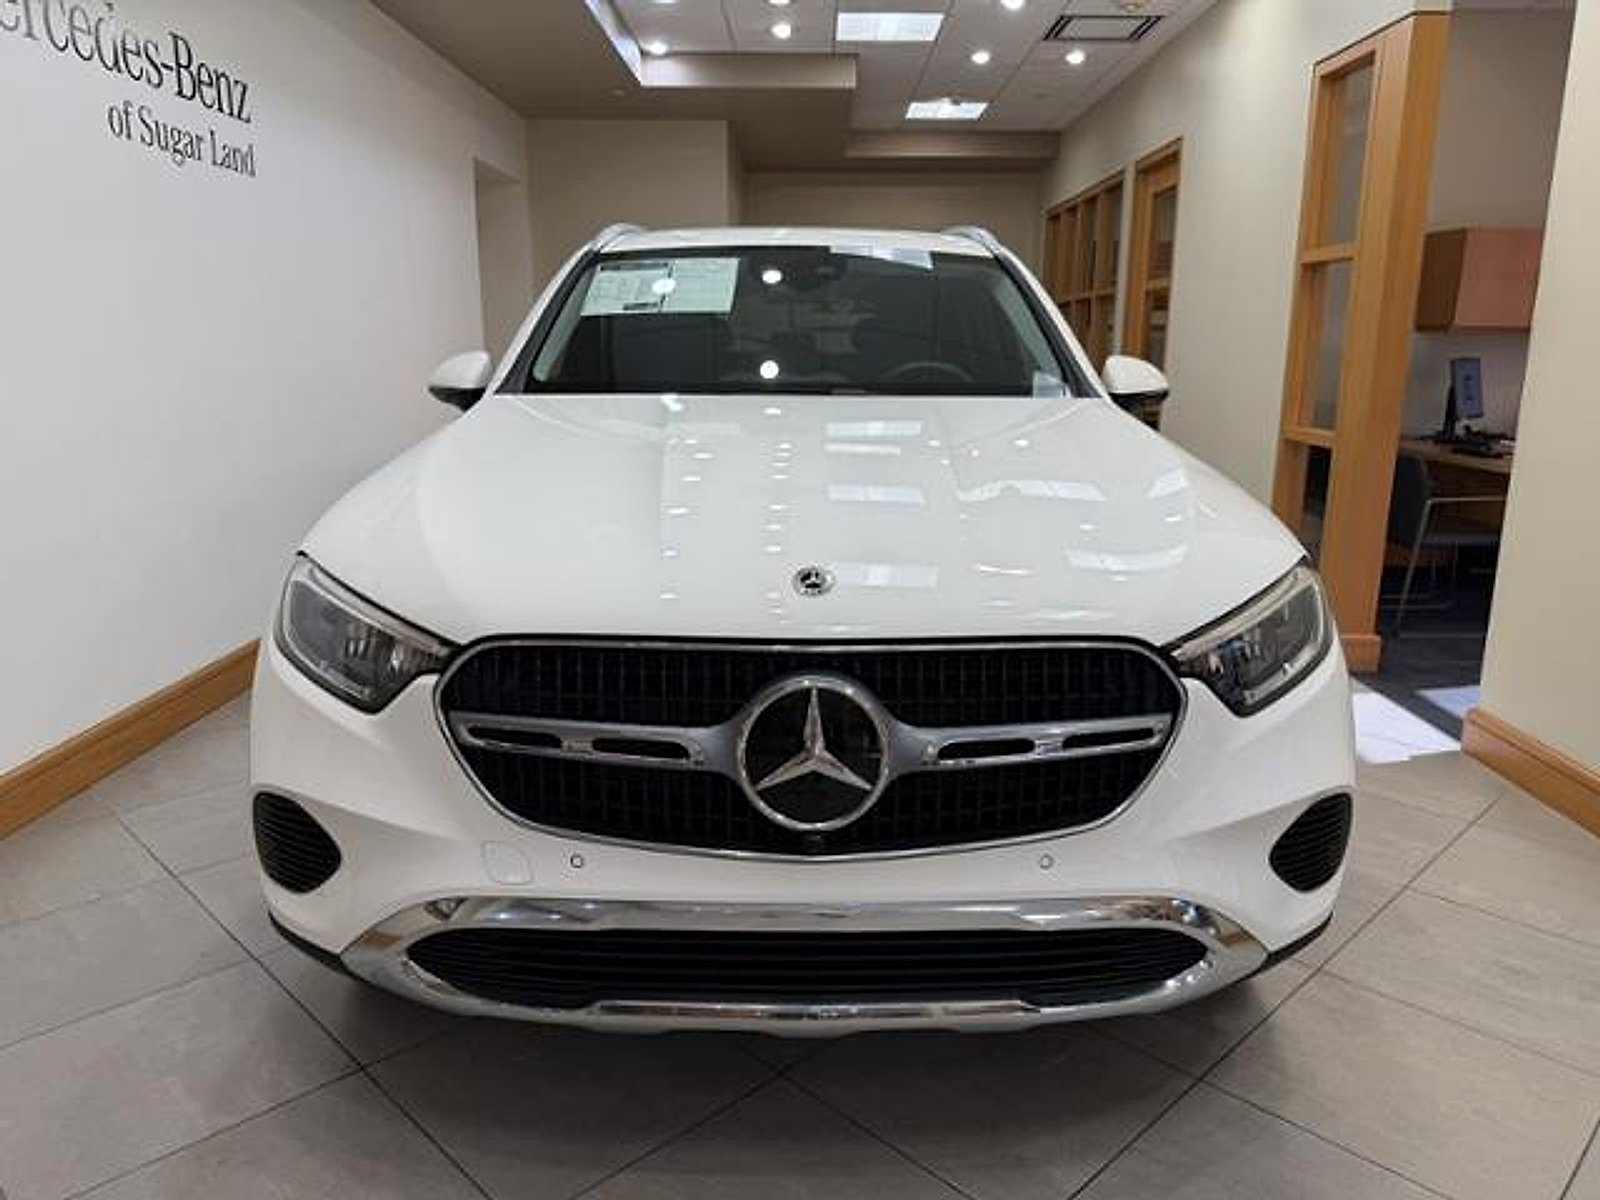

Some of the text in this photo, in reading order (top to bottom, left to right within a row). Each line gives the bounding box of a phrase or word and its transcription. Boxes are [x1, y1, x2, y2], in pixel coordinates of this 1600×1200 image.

[107, 100, 256, 178] of Sugar Land
